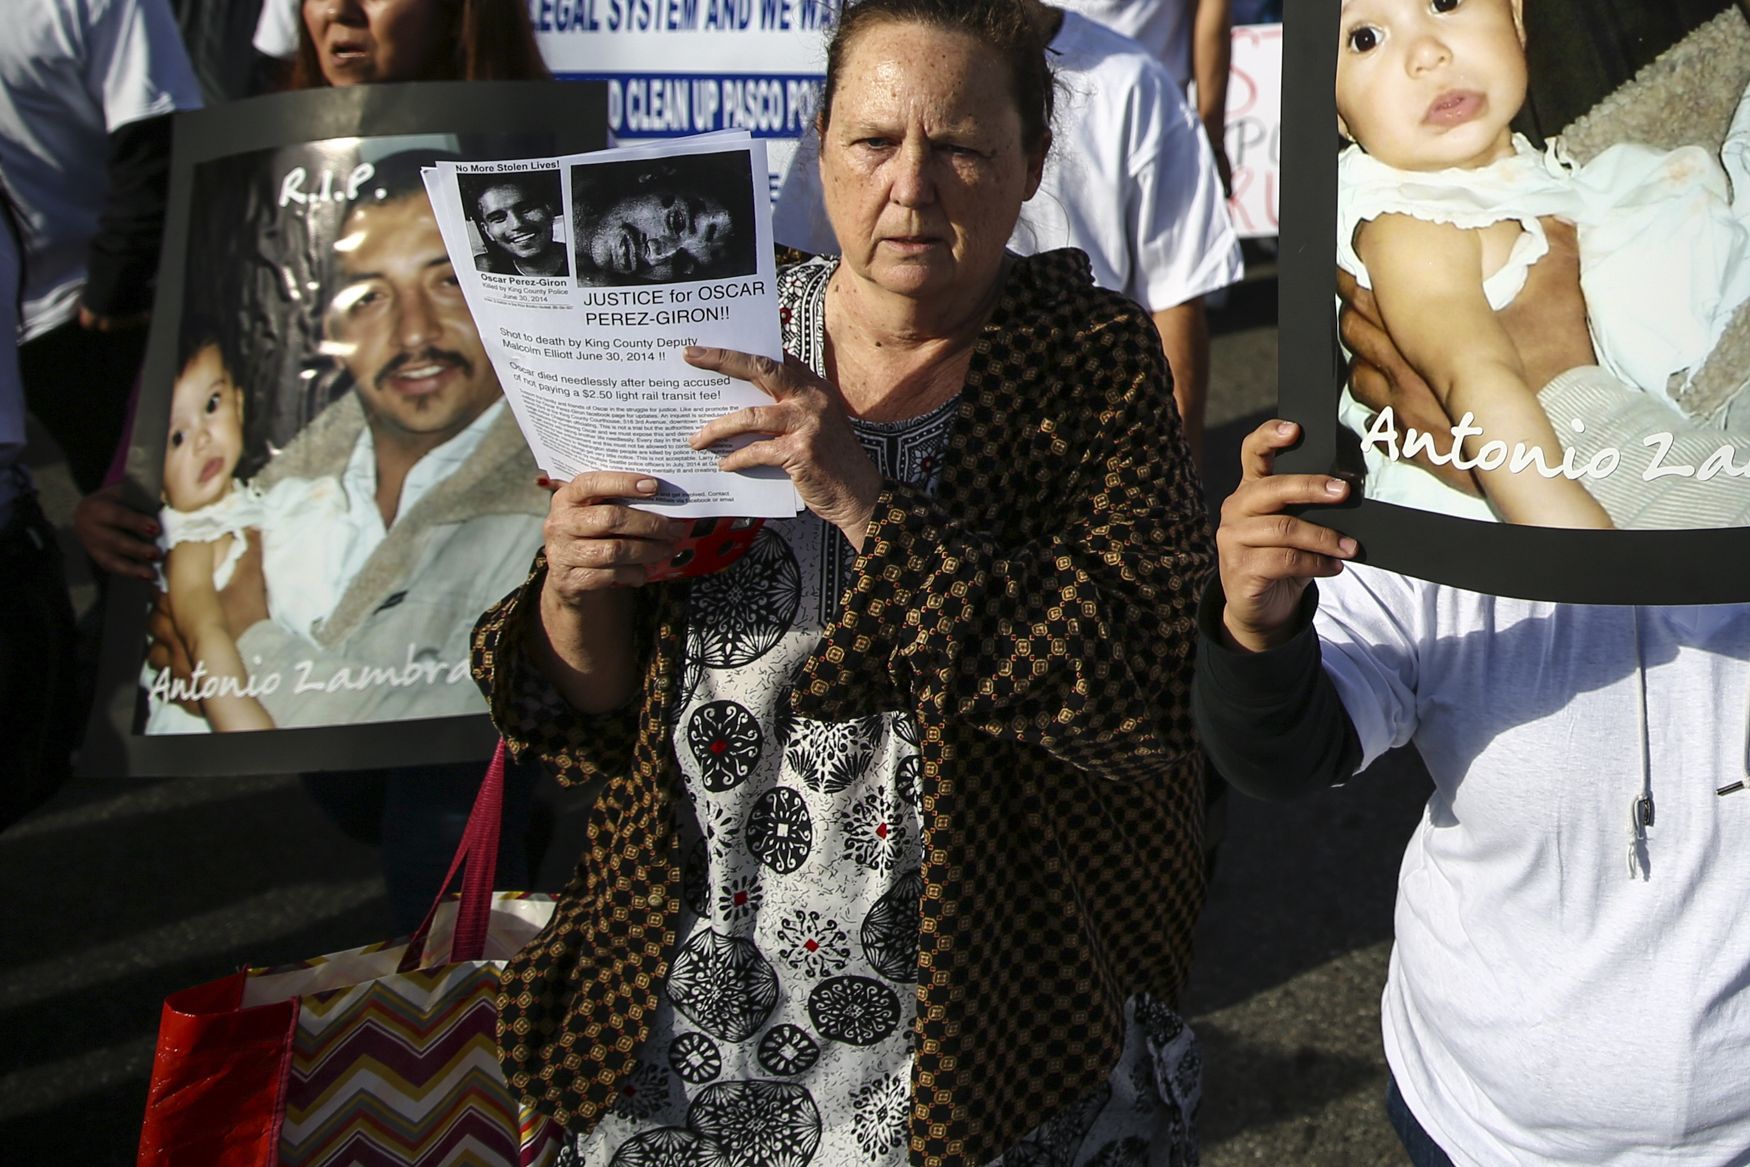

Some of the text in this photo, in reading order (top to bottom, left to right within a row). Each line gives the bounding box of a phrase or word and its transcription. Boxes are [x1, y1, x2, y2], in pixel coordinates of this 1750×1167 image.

[626, 79, 691, 131] CLEAN
[692, 79, 720, 131] UP
[722, 79, 784, 131] PASCO
[455, 160, 560, 172] No More Stolen Lives!
[278, 162, 388, 208] R.I.P.
[480, 273, 567, 287] Oscar Perez-Giron
[508, 286, 522, 294] King
[524, 287, 547, 295] County
[502, 293, 518, 301] June
[583, 290, 664, 306] JUSTICE
[669, 289, 692, 303] for
[698, 281, 765, 301] OSCAR
[585, 306, 730, 326] PEREZ-GIRON!!
[500, 327, 698, 350] Shot to death by King County Deputy
[502, 339, 666, 363] Malcolm Elliott June 30, 2014 !!
[509, 361, 731, 390] Oscar died needlessly after being accused
[513, 373, 521, 382] of
[523, 377, 537, 388] not
[539, 383, 571, 398] paying
[583, 389, 612, 400] $2.50
[615, 390, 638, 402] light
[642, 391, 659, 401] rail
[661, 391, 696, 401] transit
[699, 390, 721, 400] fee!
[1360, 404, 1622, 481] Antonio
[148, 658, 282, 705] Antonio
